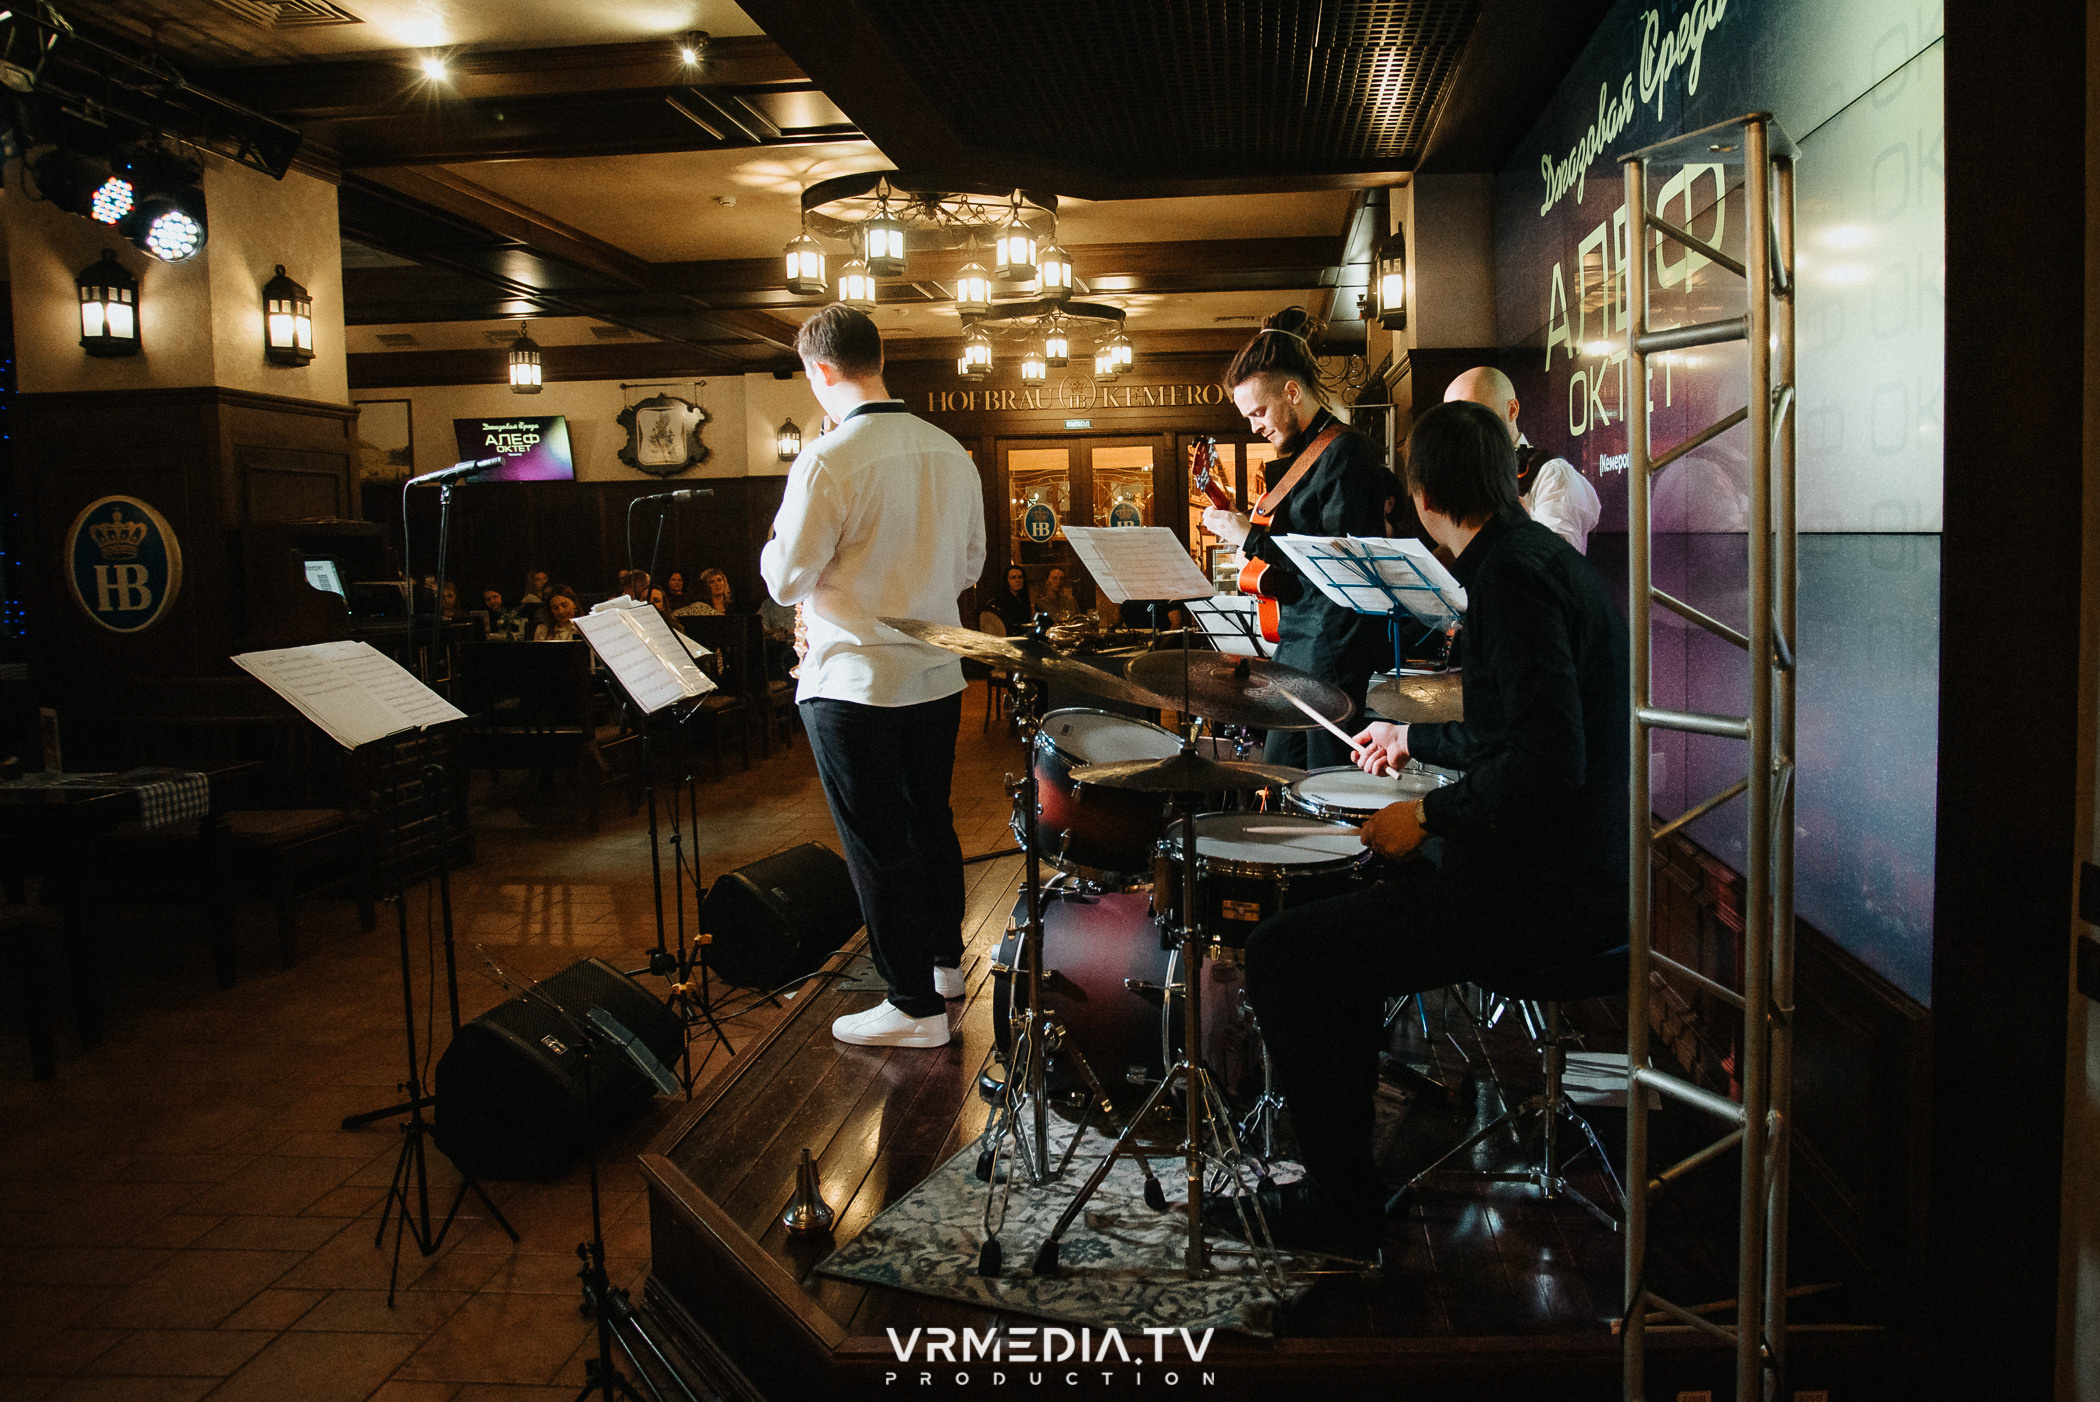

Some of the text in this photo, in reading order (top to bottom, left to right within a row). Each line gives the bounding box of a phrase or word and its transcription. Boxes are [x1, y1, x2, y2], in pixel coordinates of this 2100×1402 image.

[485, 433, 540, 446] АЛЕФ
[496, 444, 531, 453] ОКТЕТ
[1032, 522, 1050, 537] HB
[93, 564, 152, 612] HB
